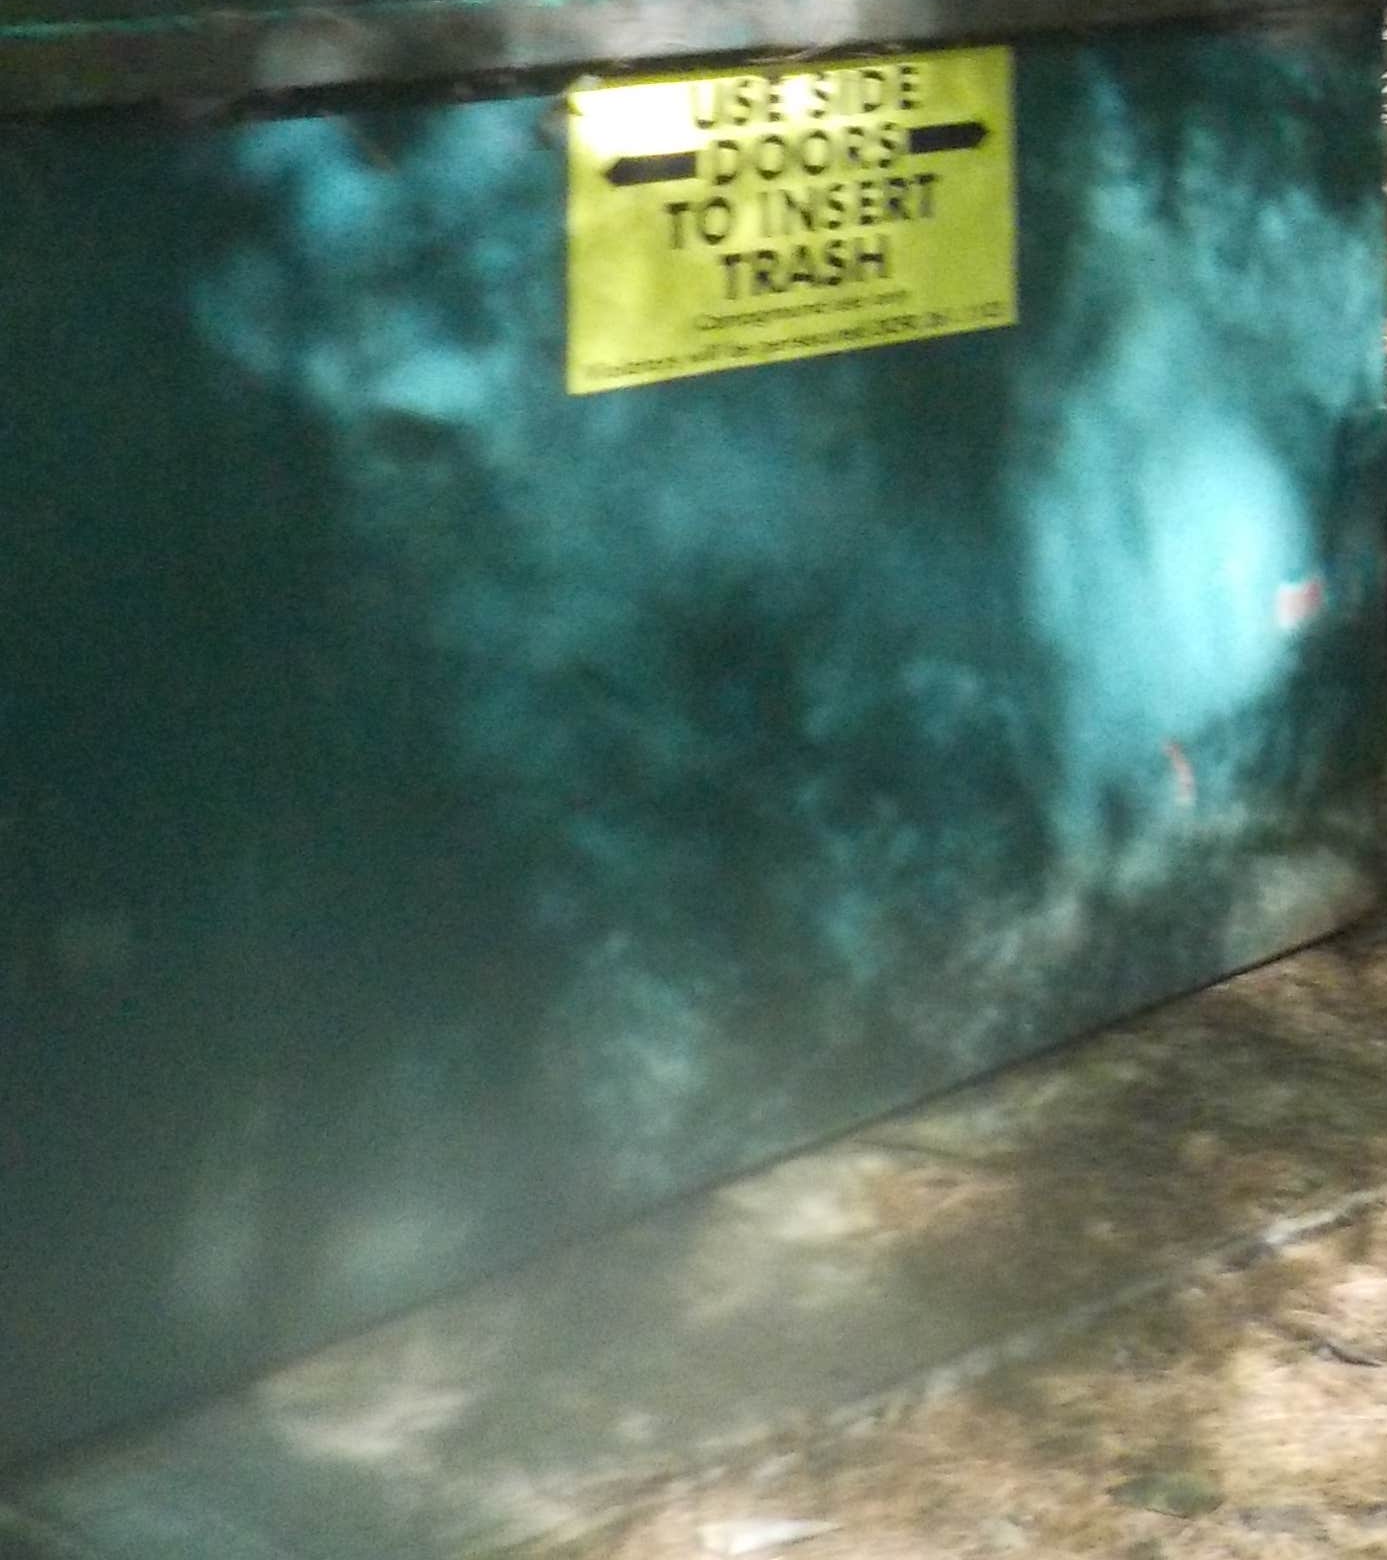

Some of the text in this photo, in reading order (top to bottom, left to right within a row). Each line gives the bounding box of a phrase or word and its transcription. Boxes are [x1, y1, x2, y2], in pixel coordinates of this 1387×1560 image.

[810, 63, 921, 120] SIDE
[704, 122, 900, 187] DOORS
[665, 173, 937, 249] TO INSERT
[721, 235, 889, 300] TRASH
